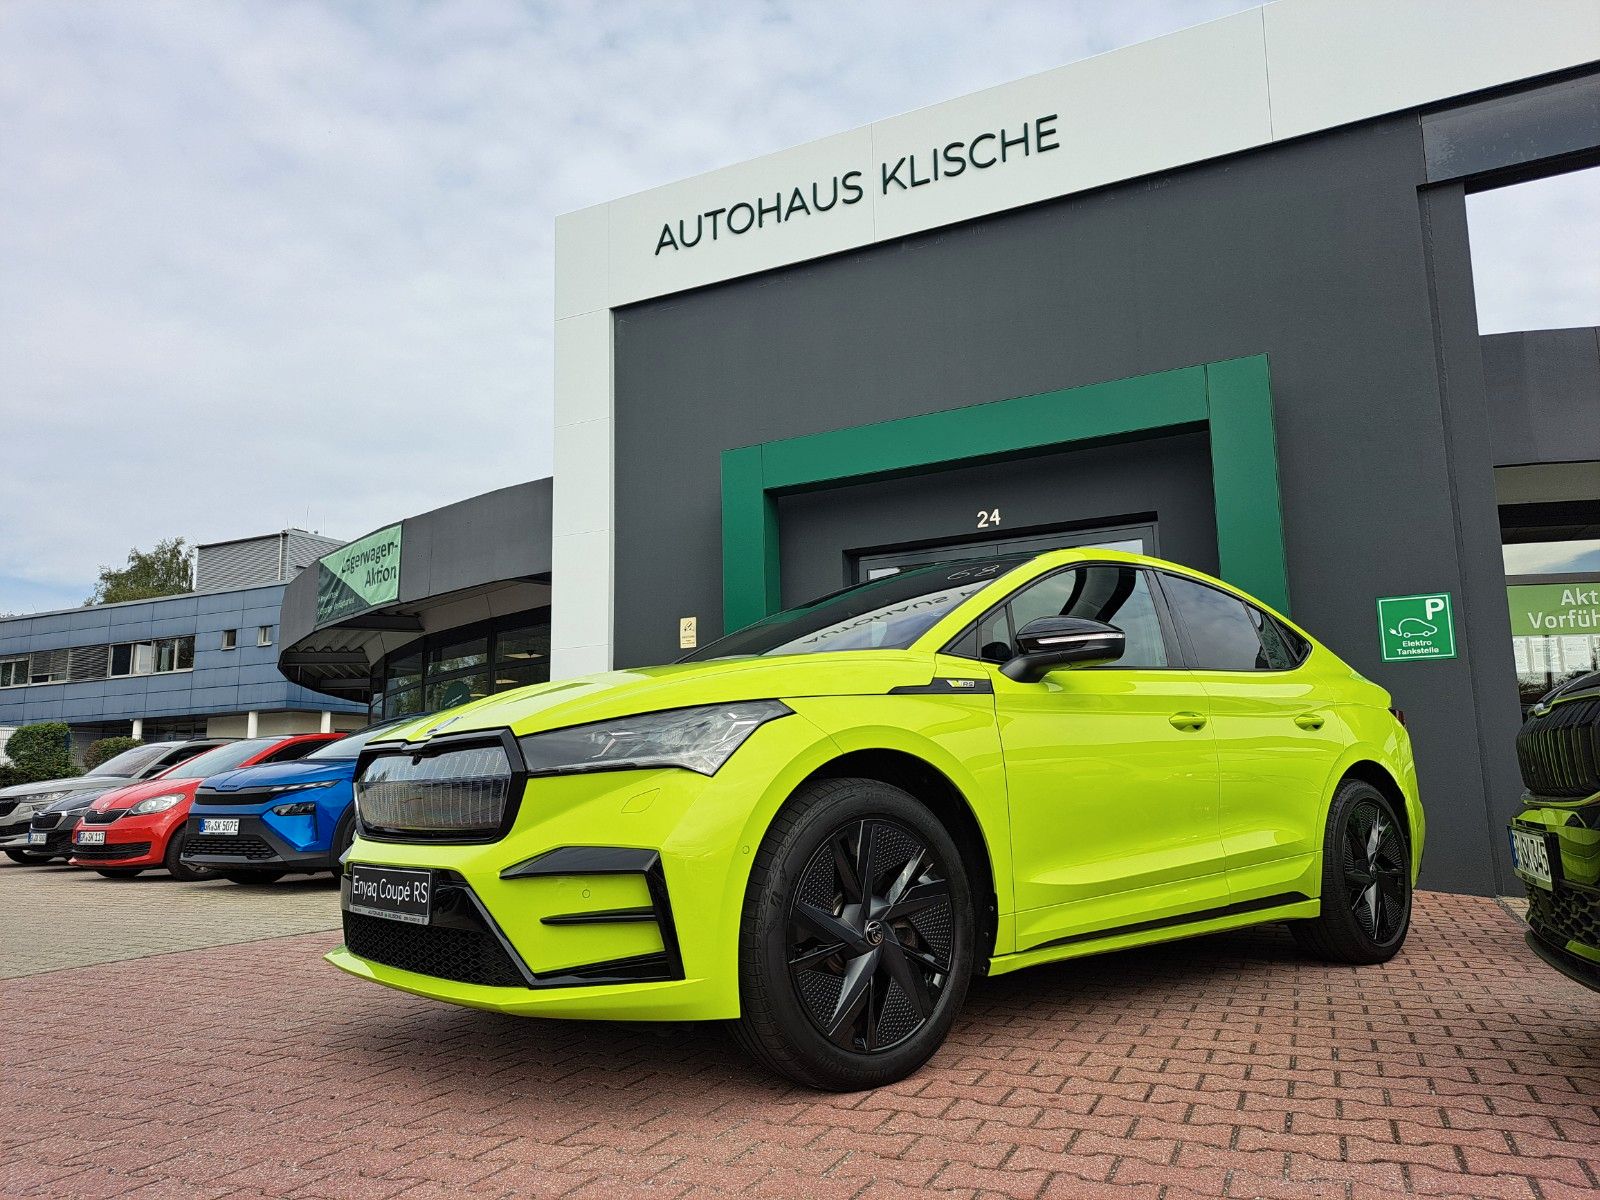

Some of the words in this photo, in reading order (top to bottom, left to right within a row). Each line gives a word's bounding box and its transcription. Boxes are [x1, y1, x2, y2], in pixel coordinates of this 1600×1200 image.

[654, 170, 864, 256] AUTOHAUS
[882, 113, 1060, 195] KLISCHE
[976, 508, 1001, 528] 24
[364, 564, 397, 588] Aktion
[1425, 598, 1445, 620] P
[1396, 646, 1440, 655] Tankstelle
[353, 875, 378, 902] Enyaq
[379, 878, 411, 905] Coupé
[413, 881, 428, 904] RS
